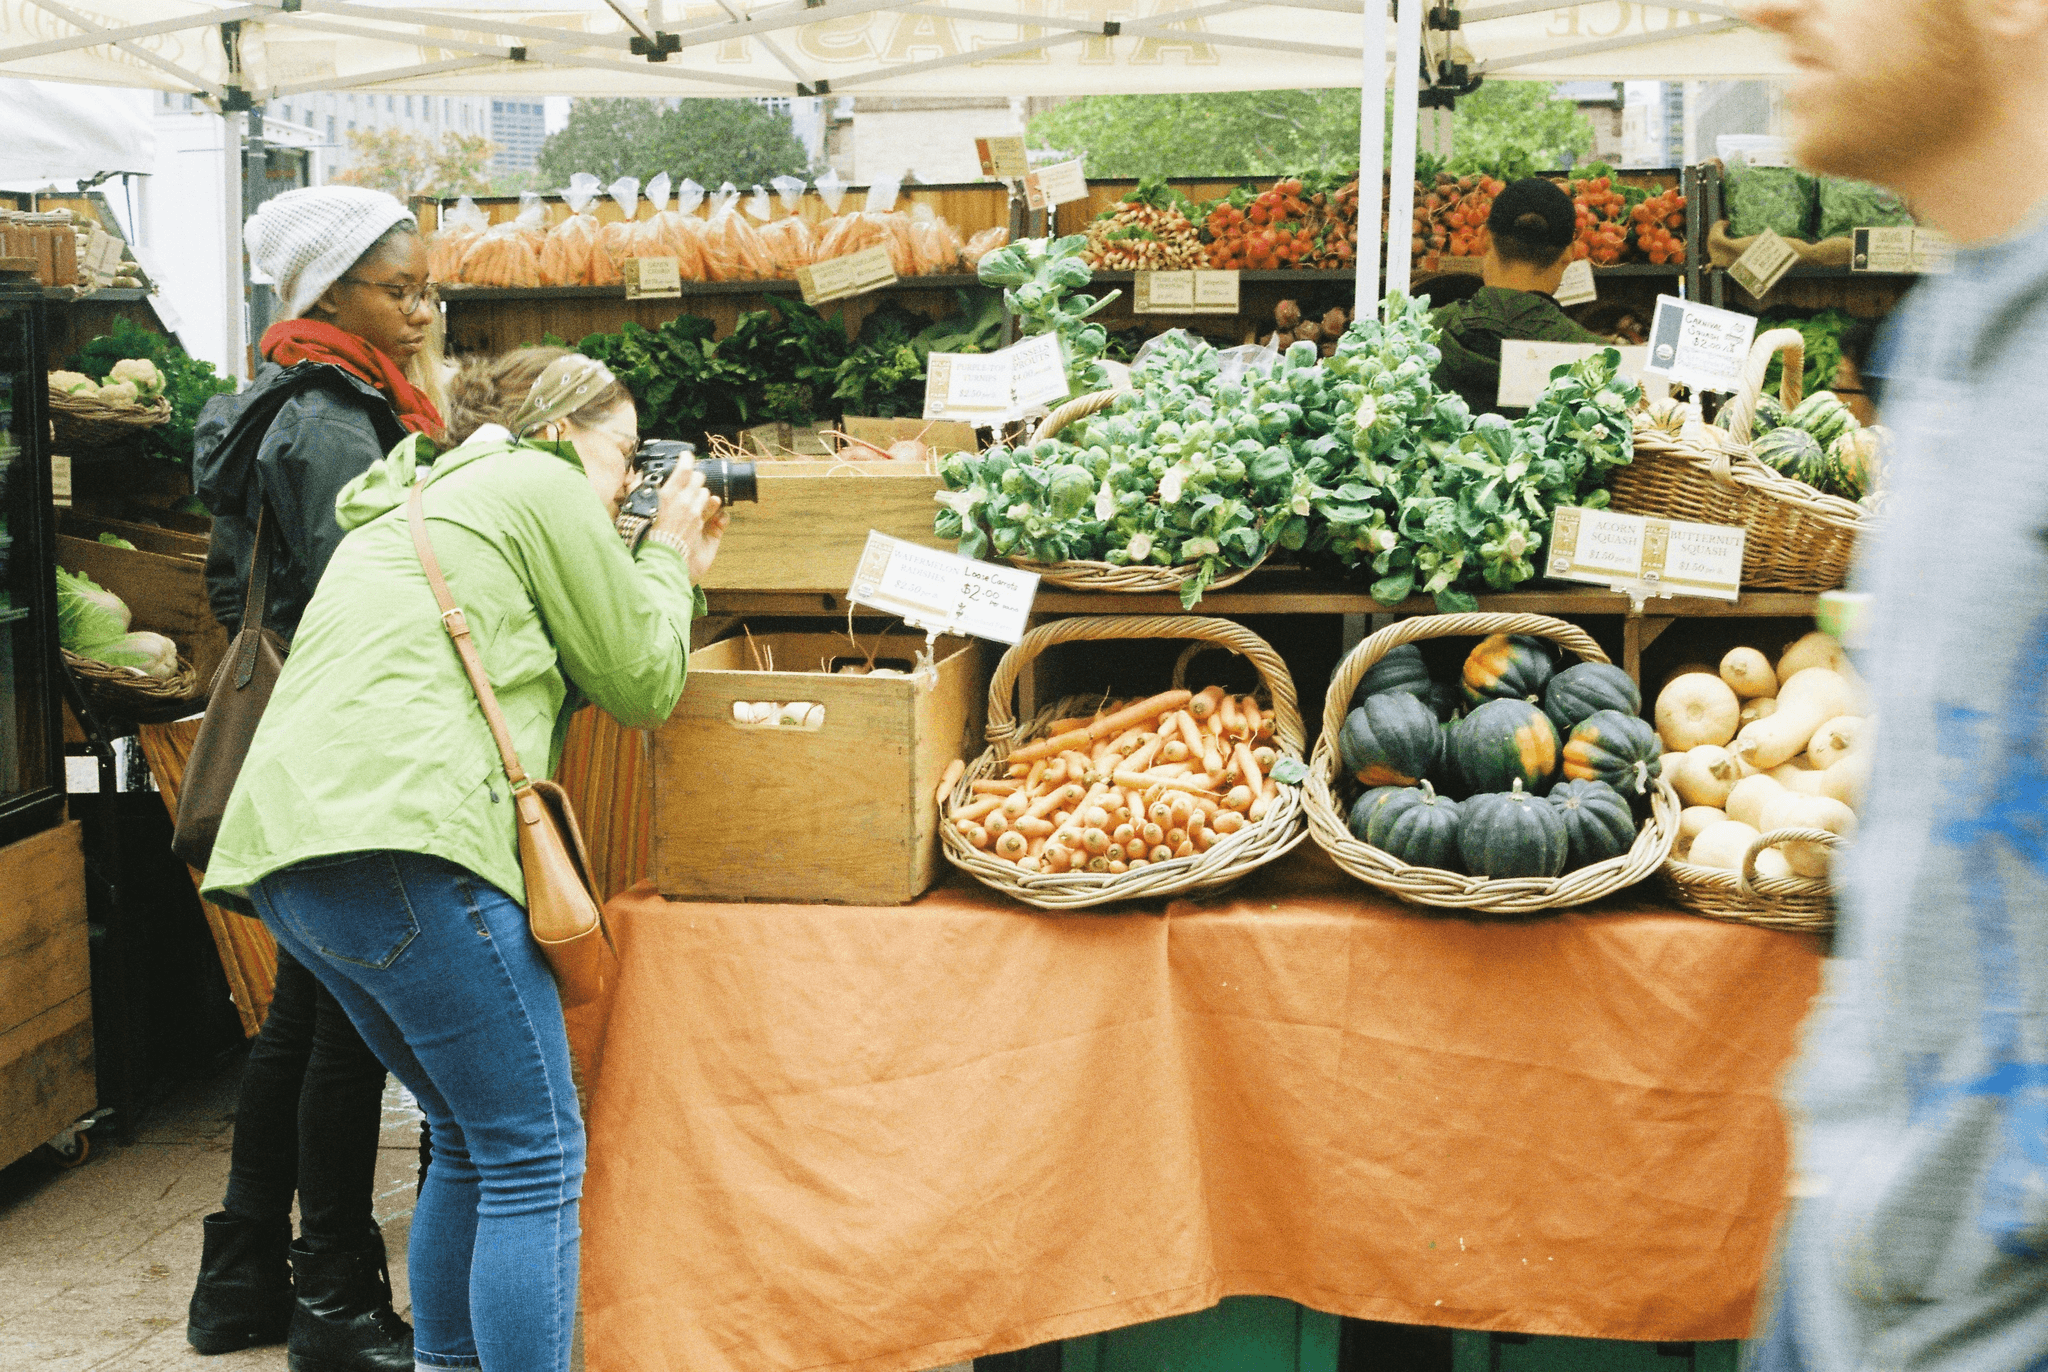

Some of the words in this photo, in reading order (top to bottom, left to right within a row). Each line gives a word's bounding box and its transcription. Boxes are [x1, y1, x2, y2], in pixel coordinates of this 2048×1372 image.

[1596, 521, 1637, 534] ACORN
[1591, 531, 1638, 546] SQUASH
[1670, 530, 1743, 546] BUTTERNUT
[1589, 549, 1615, 561] $1.50
[1681, 543, 1728, 557] SQUASH
[894, 549, 961, 575] WATERMELON
[1679, 561, 1705, 573] $1.50
[901, 563, 946, 583] RADISHES
[964, 566, 990, 582] Loose
[991, 573, 1018, 591] Carrots
[960, 583, 1000, 602] $2.00
